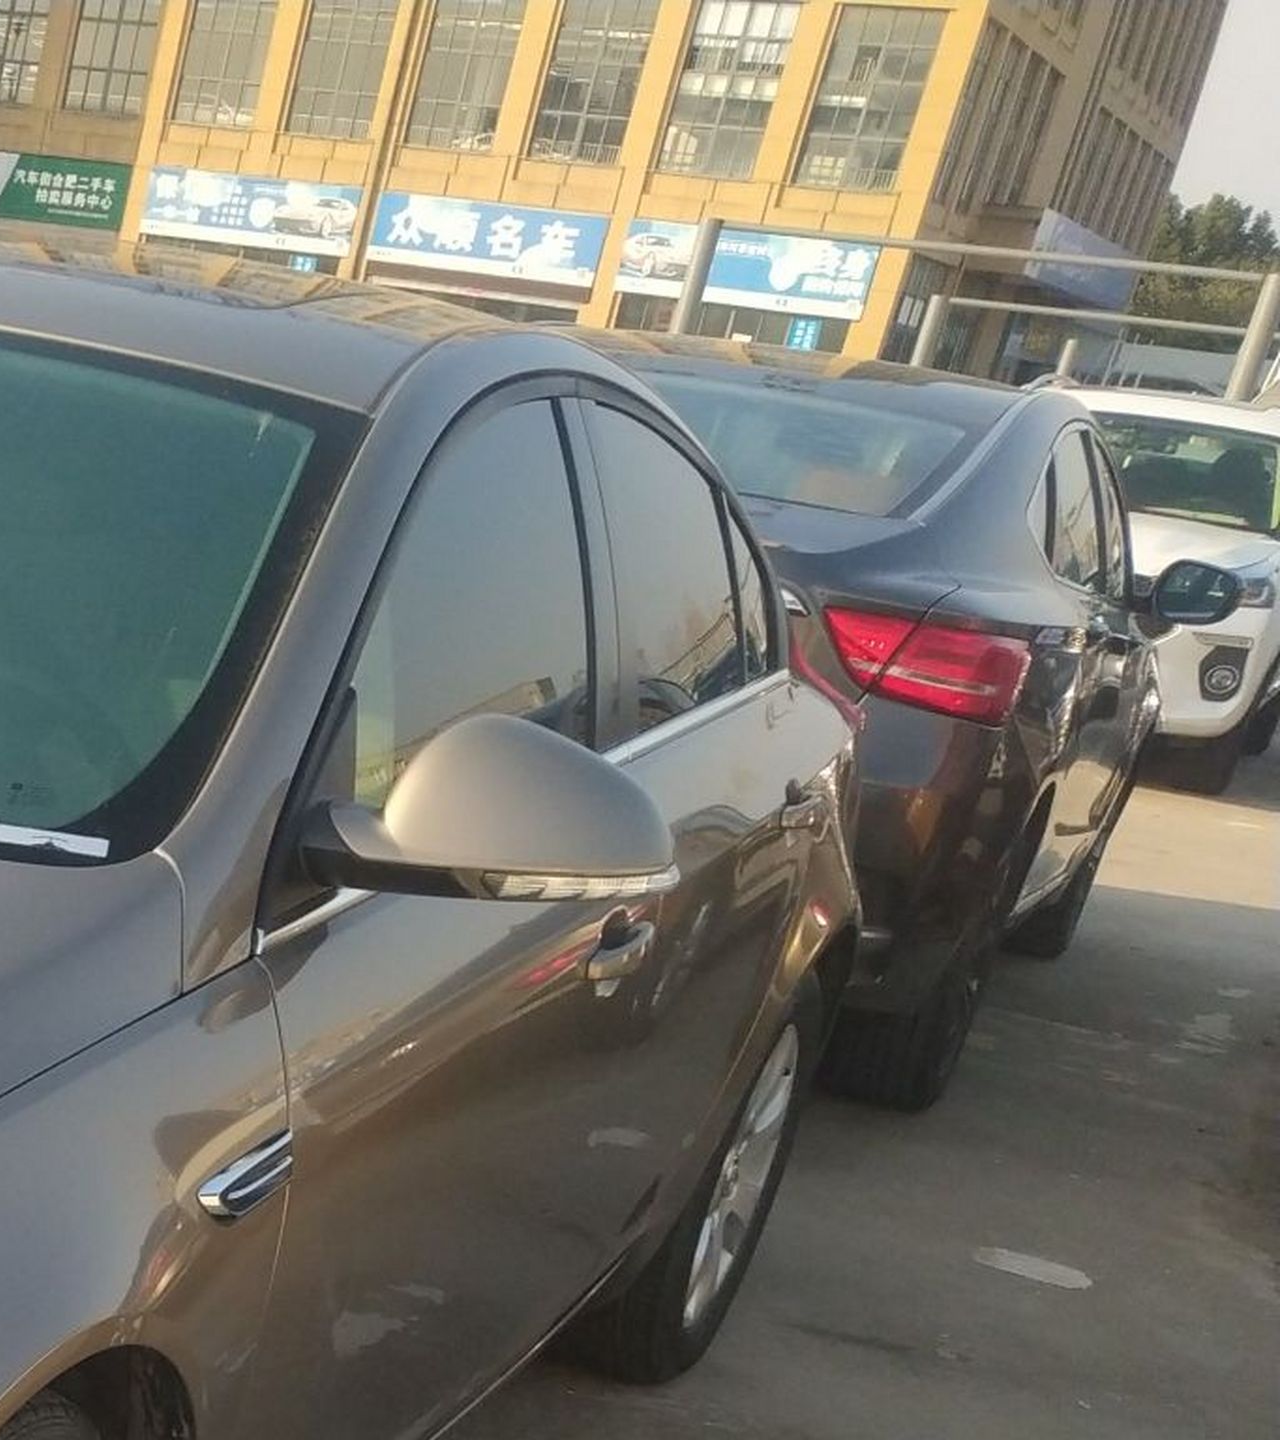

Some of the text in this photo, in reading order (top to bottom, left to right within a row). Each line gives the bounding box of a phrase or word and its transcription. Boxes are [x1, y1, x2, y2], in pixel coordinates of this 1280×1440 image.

[13, 168, 116, 194] 汽车街合肥二手车
[35, 188, 113, 212] 拍卖服务中心
